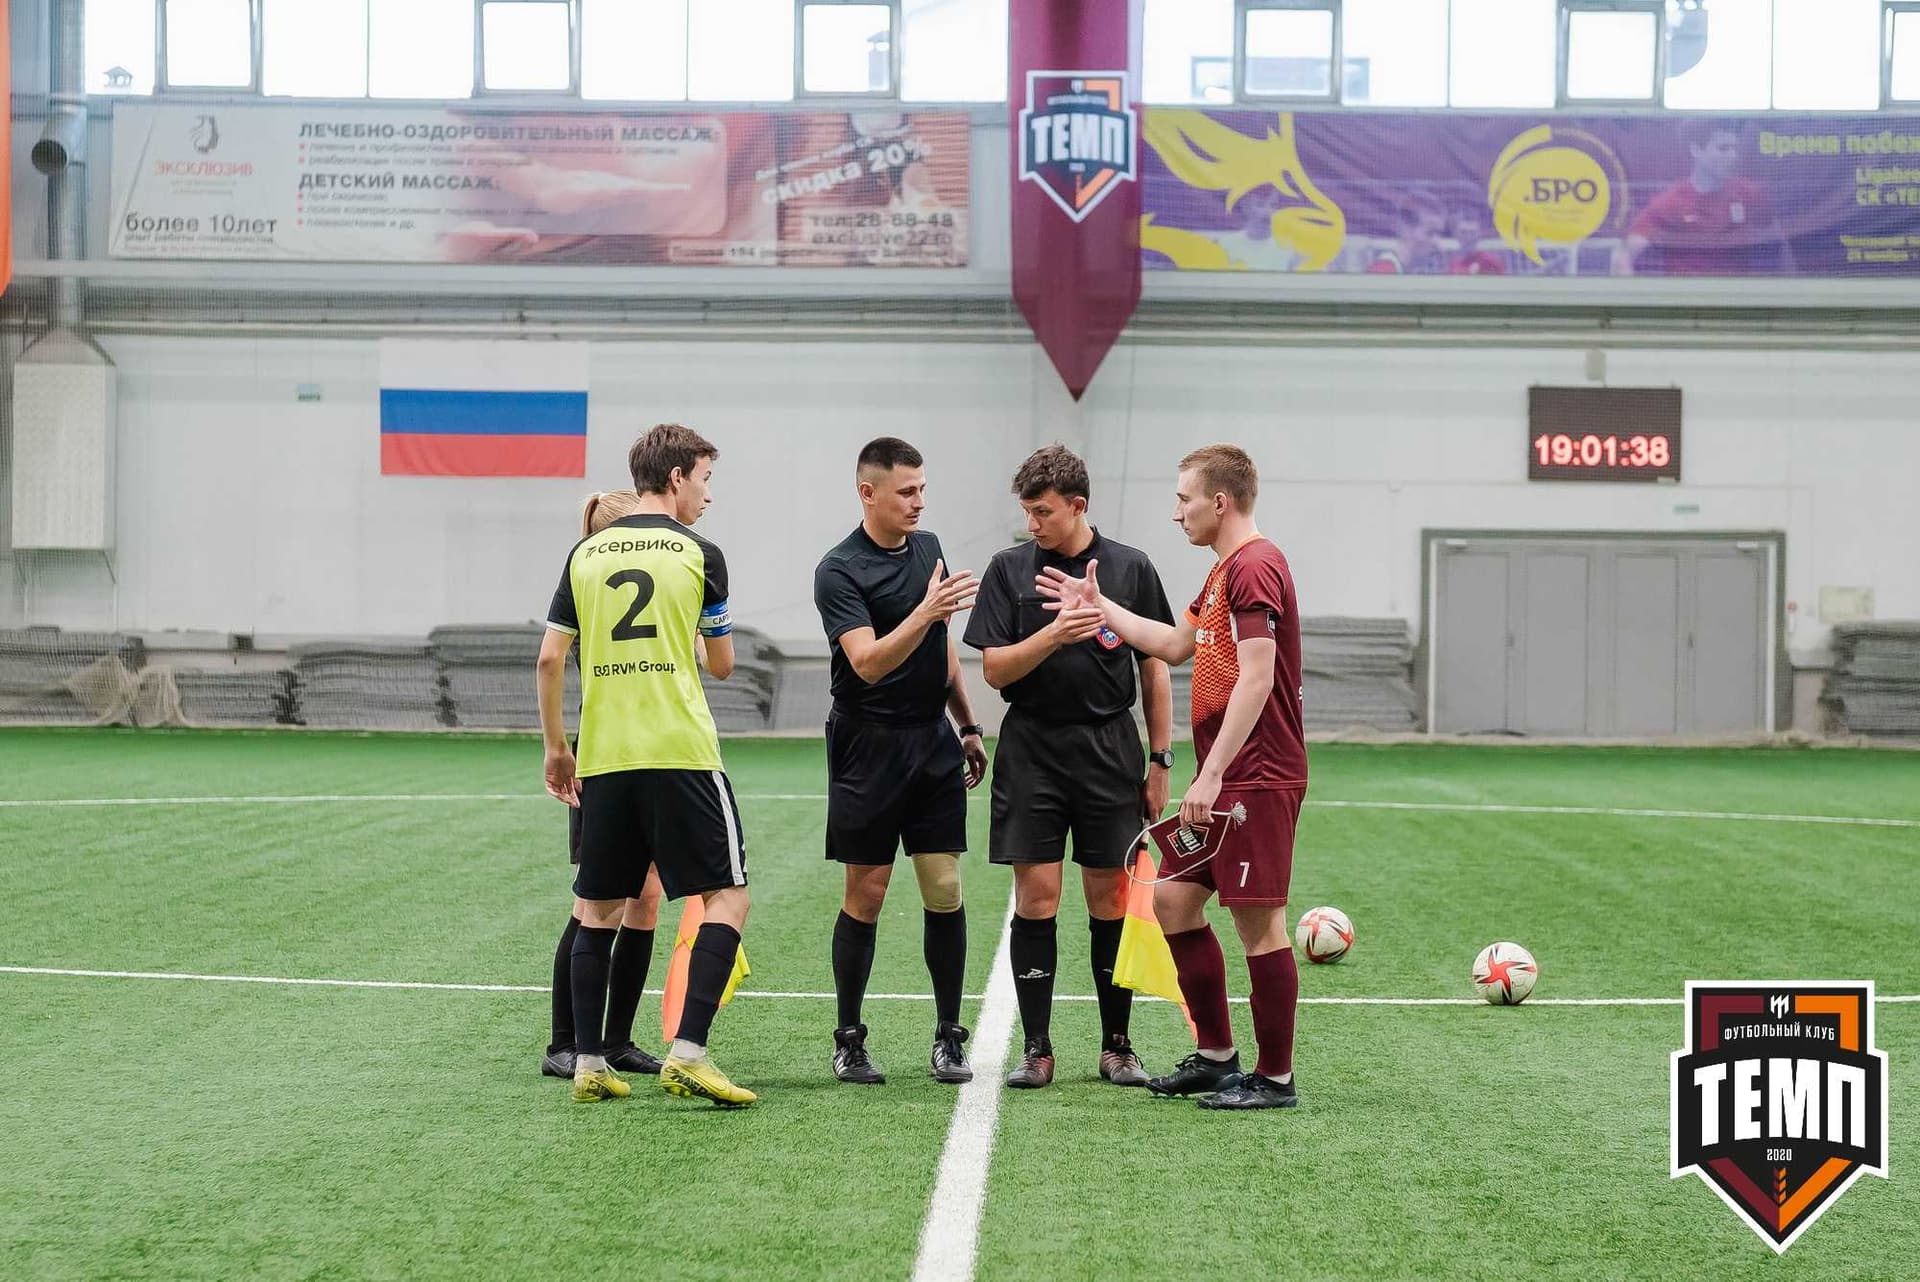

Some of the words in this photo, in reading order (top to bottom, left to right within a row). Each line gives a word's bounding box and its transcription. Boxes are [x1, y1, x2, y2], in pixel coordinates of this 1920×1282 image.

[300, 123, 614, 141] ЛЕЧЕБНО-ОЗДОРОВИТЕЛЬНЫЙ
[1031, 113, 1125, 165] ТЕМП
[867, 136, 933, 173] 20%
[154, 161, 254, 176] ЭКСКЛЮЗИВ
[299, 173, 395, 189] ДЕТСКИЙ
[126, 212, 200, 233] более
[1535, 434, 1671, 467] 19:01:38
[598, 539, 684, 554] сервико
[605, 568, 658, 642] 2
[612, 662, 636, 675] RVM
[639, 661, 676, 674] Group
[1239, 862, 1250, 888] 7
